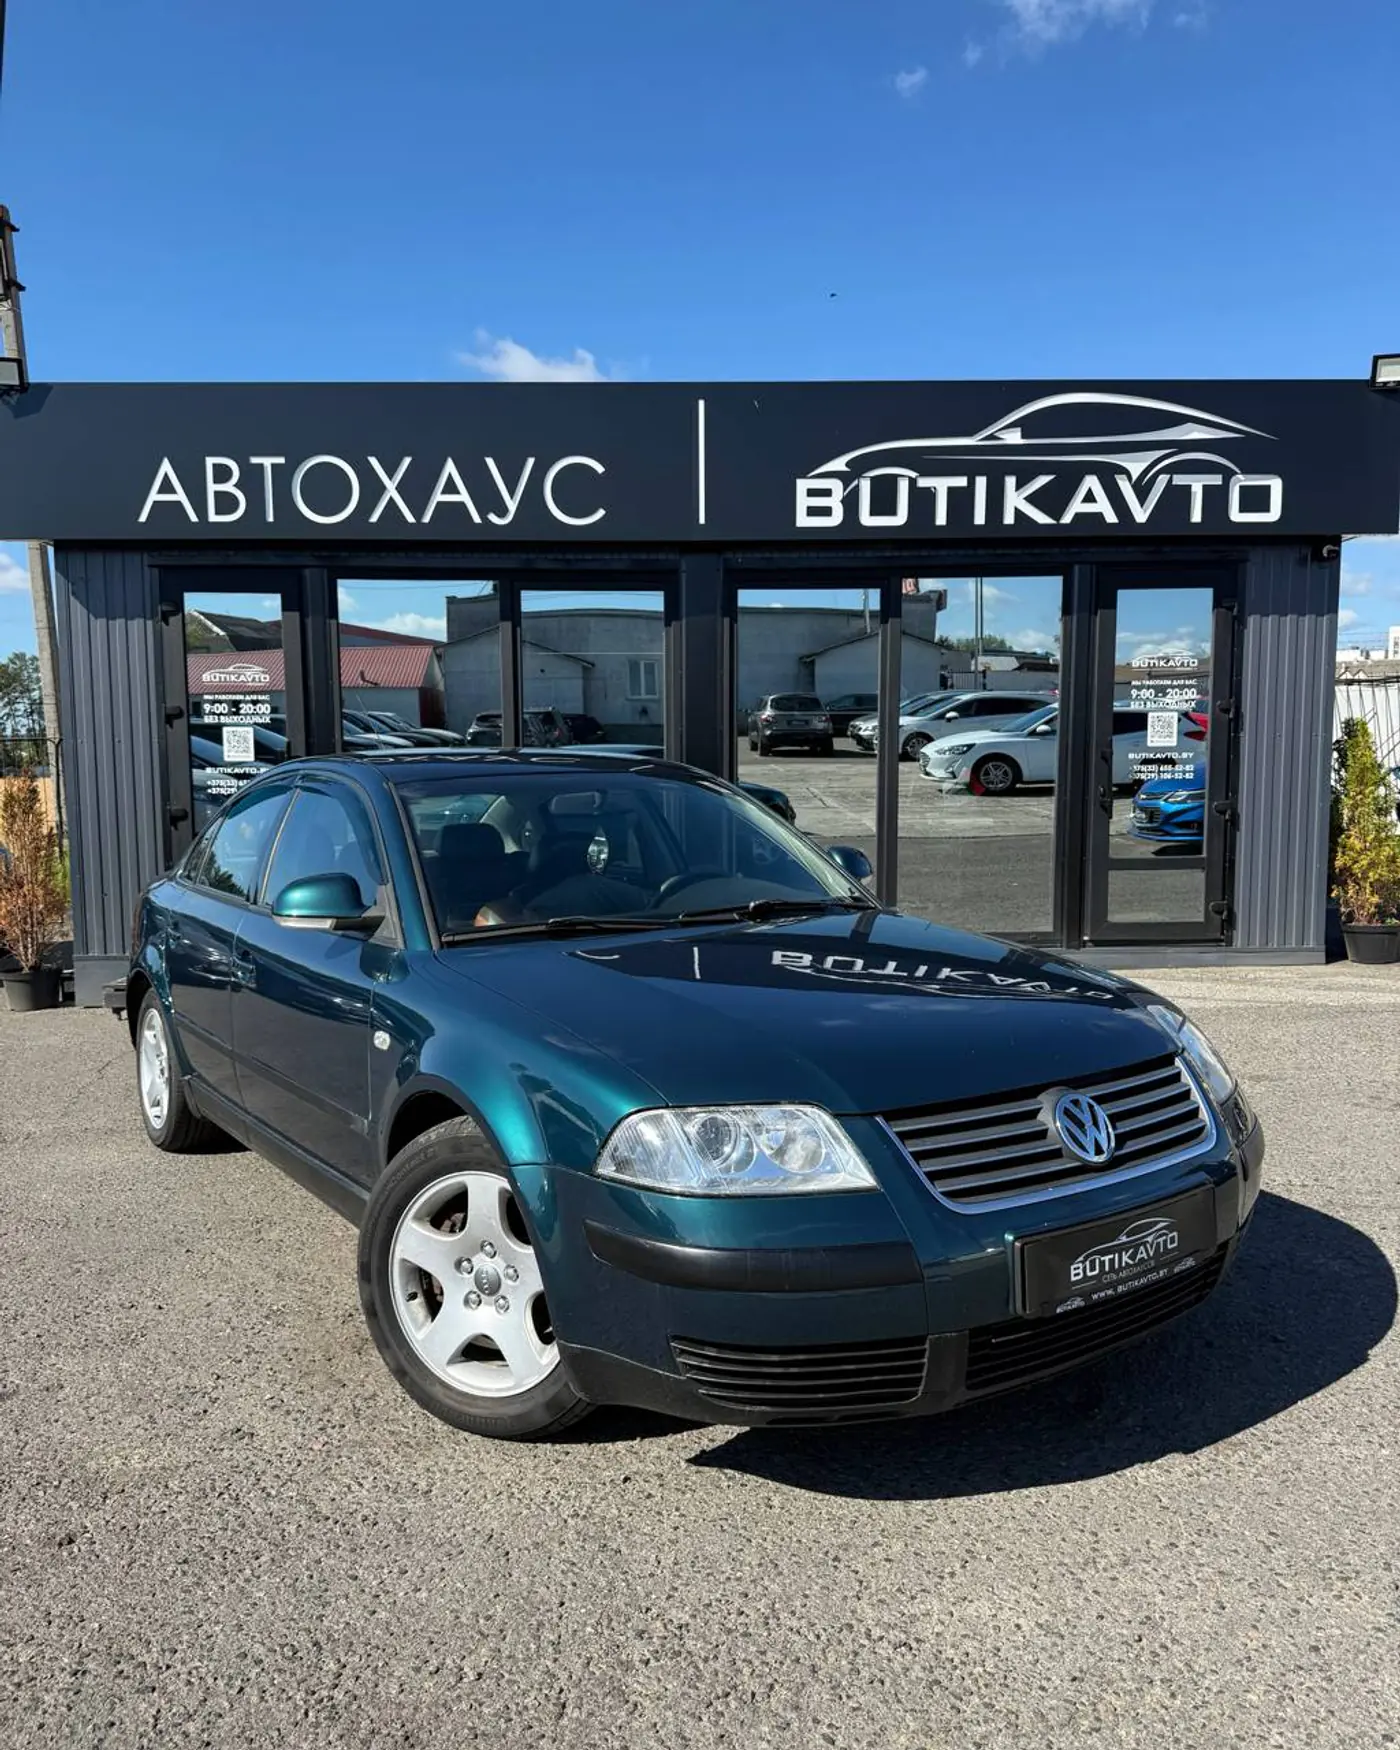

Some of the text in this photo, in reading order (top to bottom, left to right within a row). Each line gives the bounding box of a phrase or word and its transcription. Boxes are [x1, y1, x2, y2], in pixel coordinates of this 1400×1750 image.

[138, 455, 607, 526] АВТОХАУС
[795, 473, 1284, 528] BUTIKAVTO
[1131, 659, 1198, 668] BUTIKAVTO
[202, 674, 270, 683] BUTIKAVTO
[1130, 689, 1155, 699] 9:00
[1166, 688, 1197, 699] 20:00
[203, 703, 228, 714] 9:00
[239, 703, 271, 714] 20:00
[203, 715, 271, 724] БЕЗ ВЫХОДНЫХ
[1070, 1231, 1178, 1282] BUTIKAVTO
